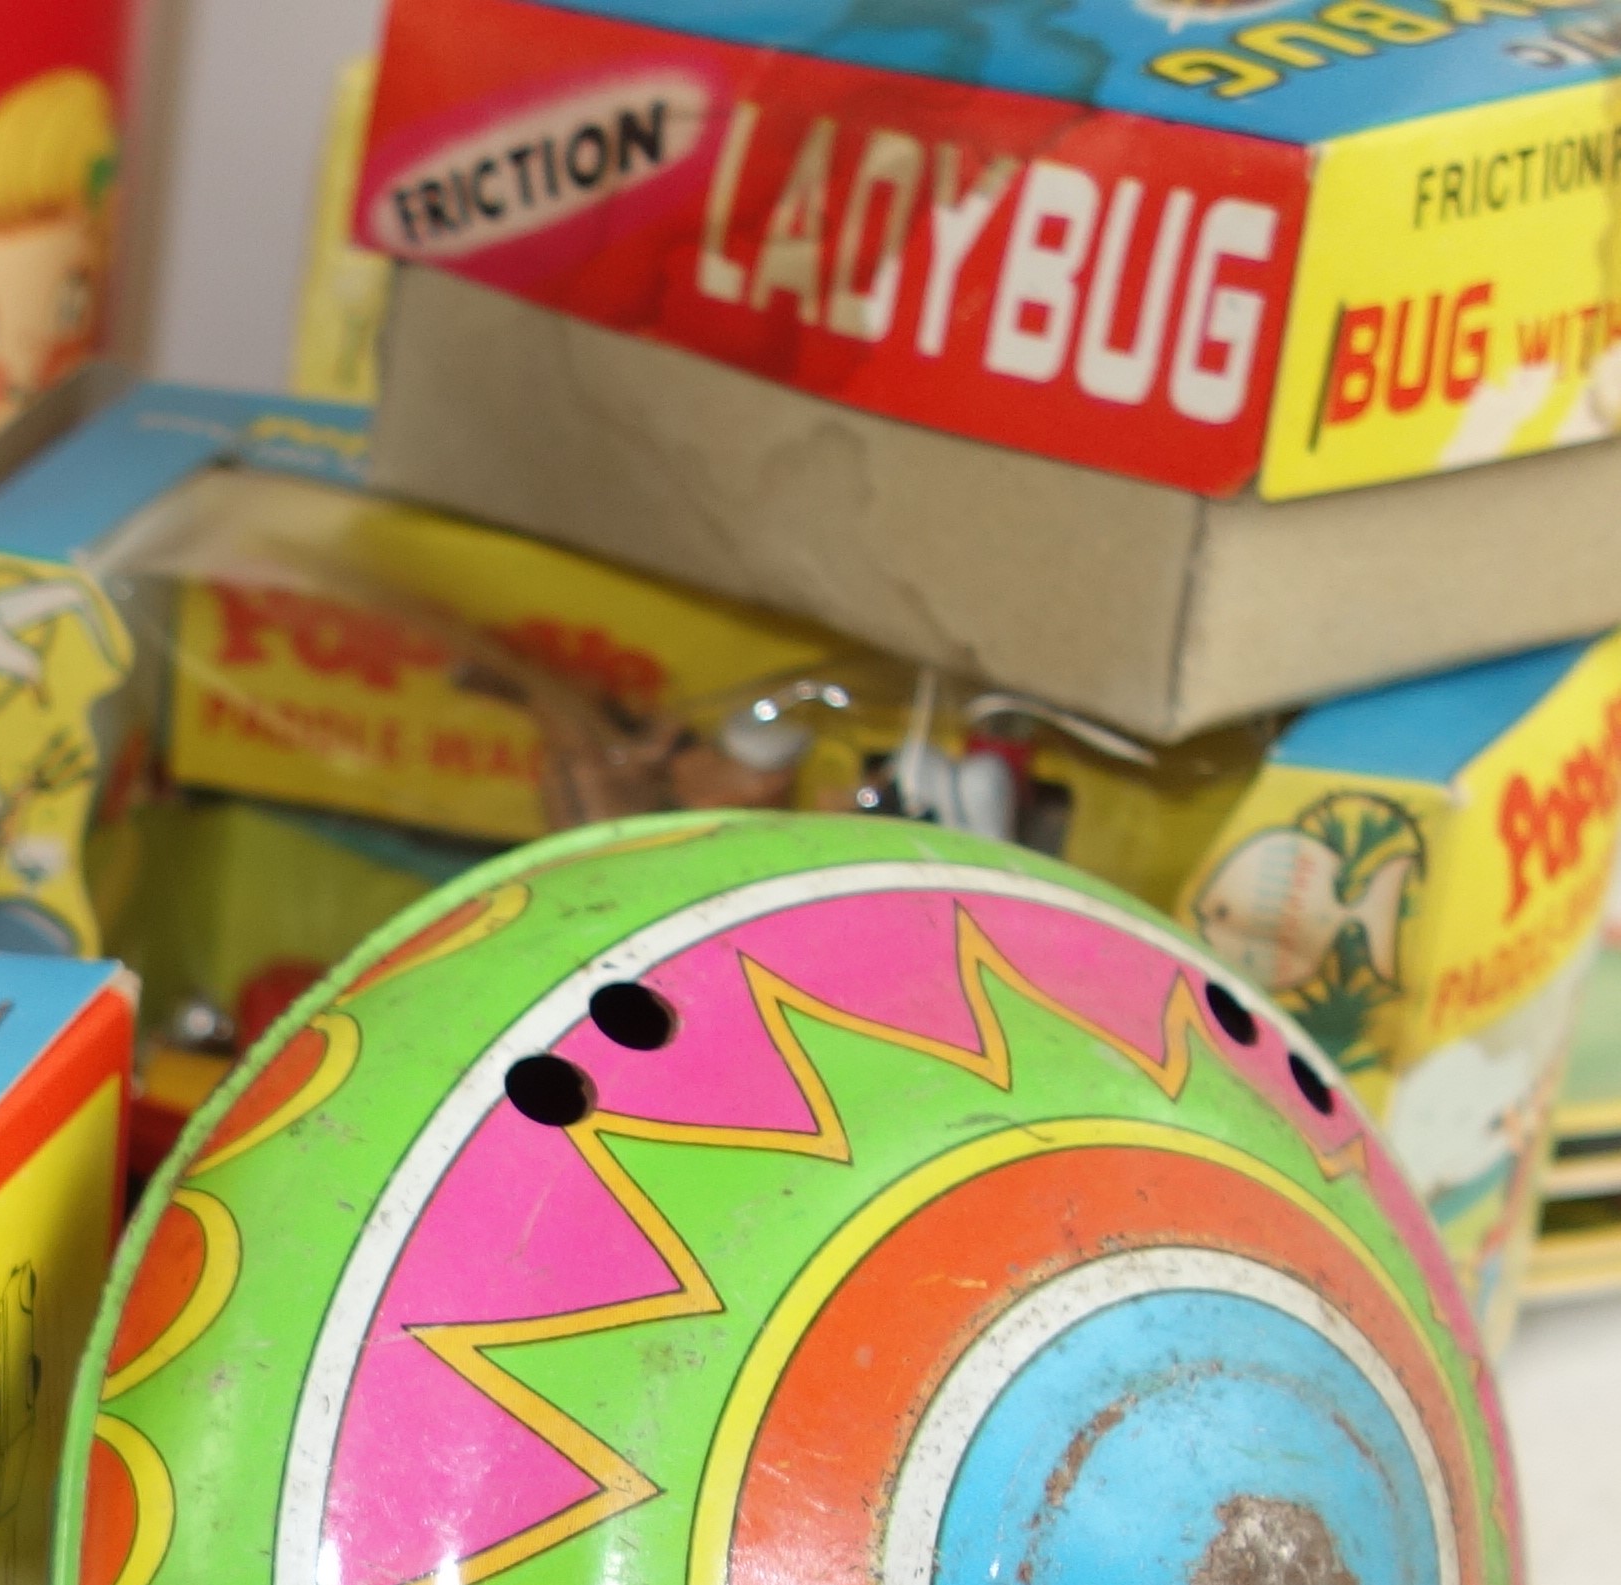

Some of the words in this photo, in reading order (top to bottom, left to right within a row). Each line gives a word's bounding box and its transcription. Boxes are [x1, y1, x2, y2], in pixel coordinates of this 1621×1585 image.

[394, 100, 669, 242] FRICTION
[694, 100, 1279, 424] LADYBUG
[1324, 281, 1495, 428] BUG
